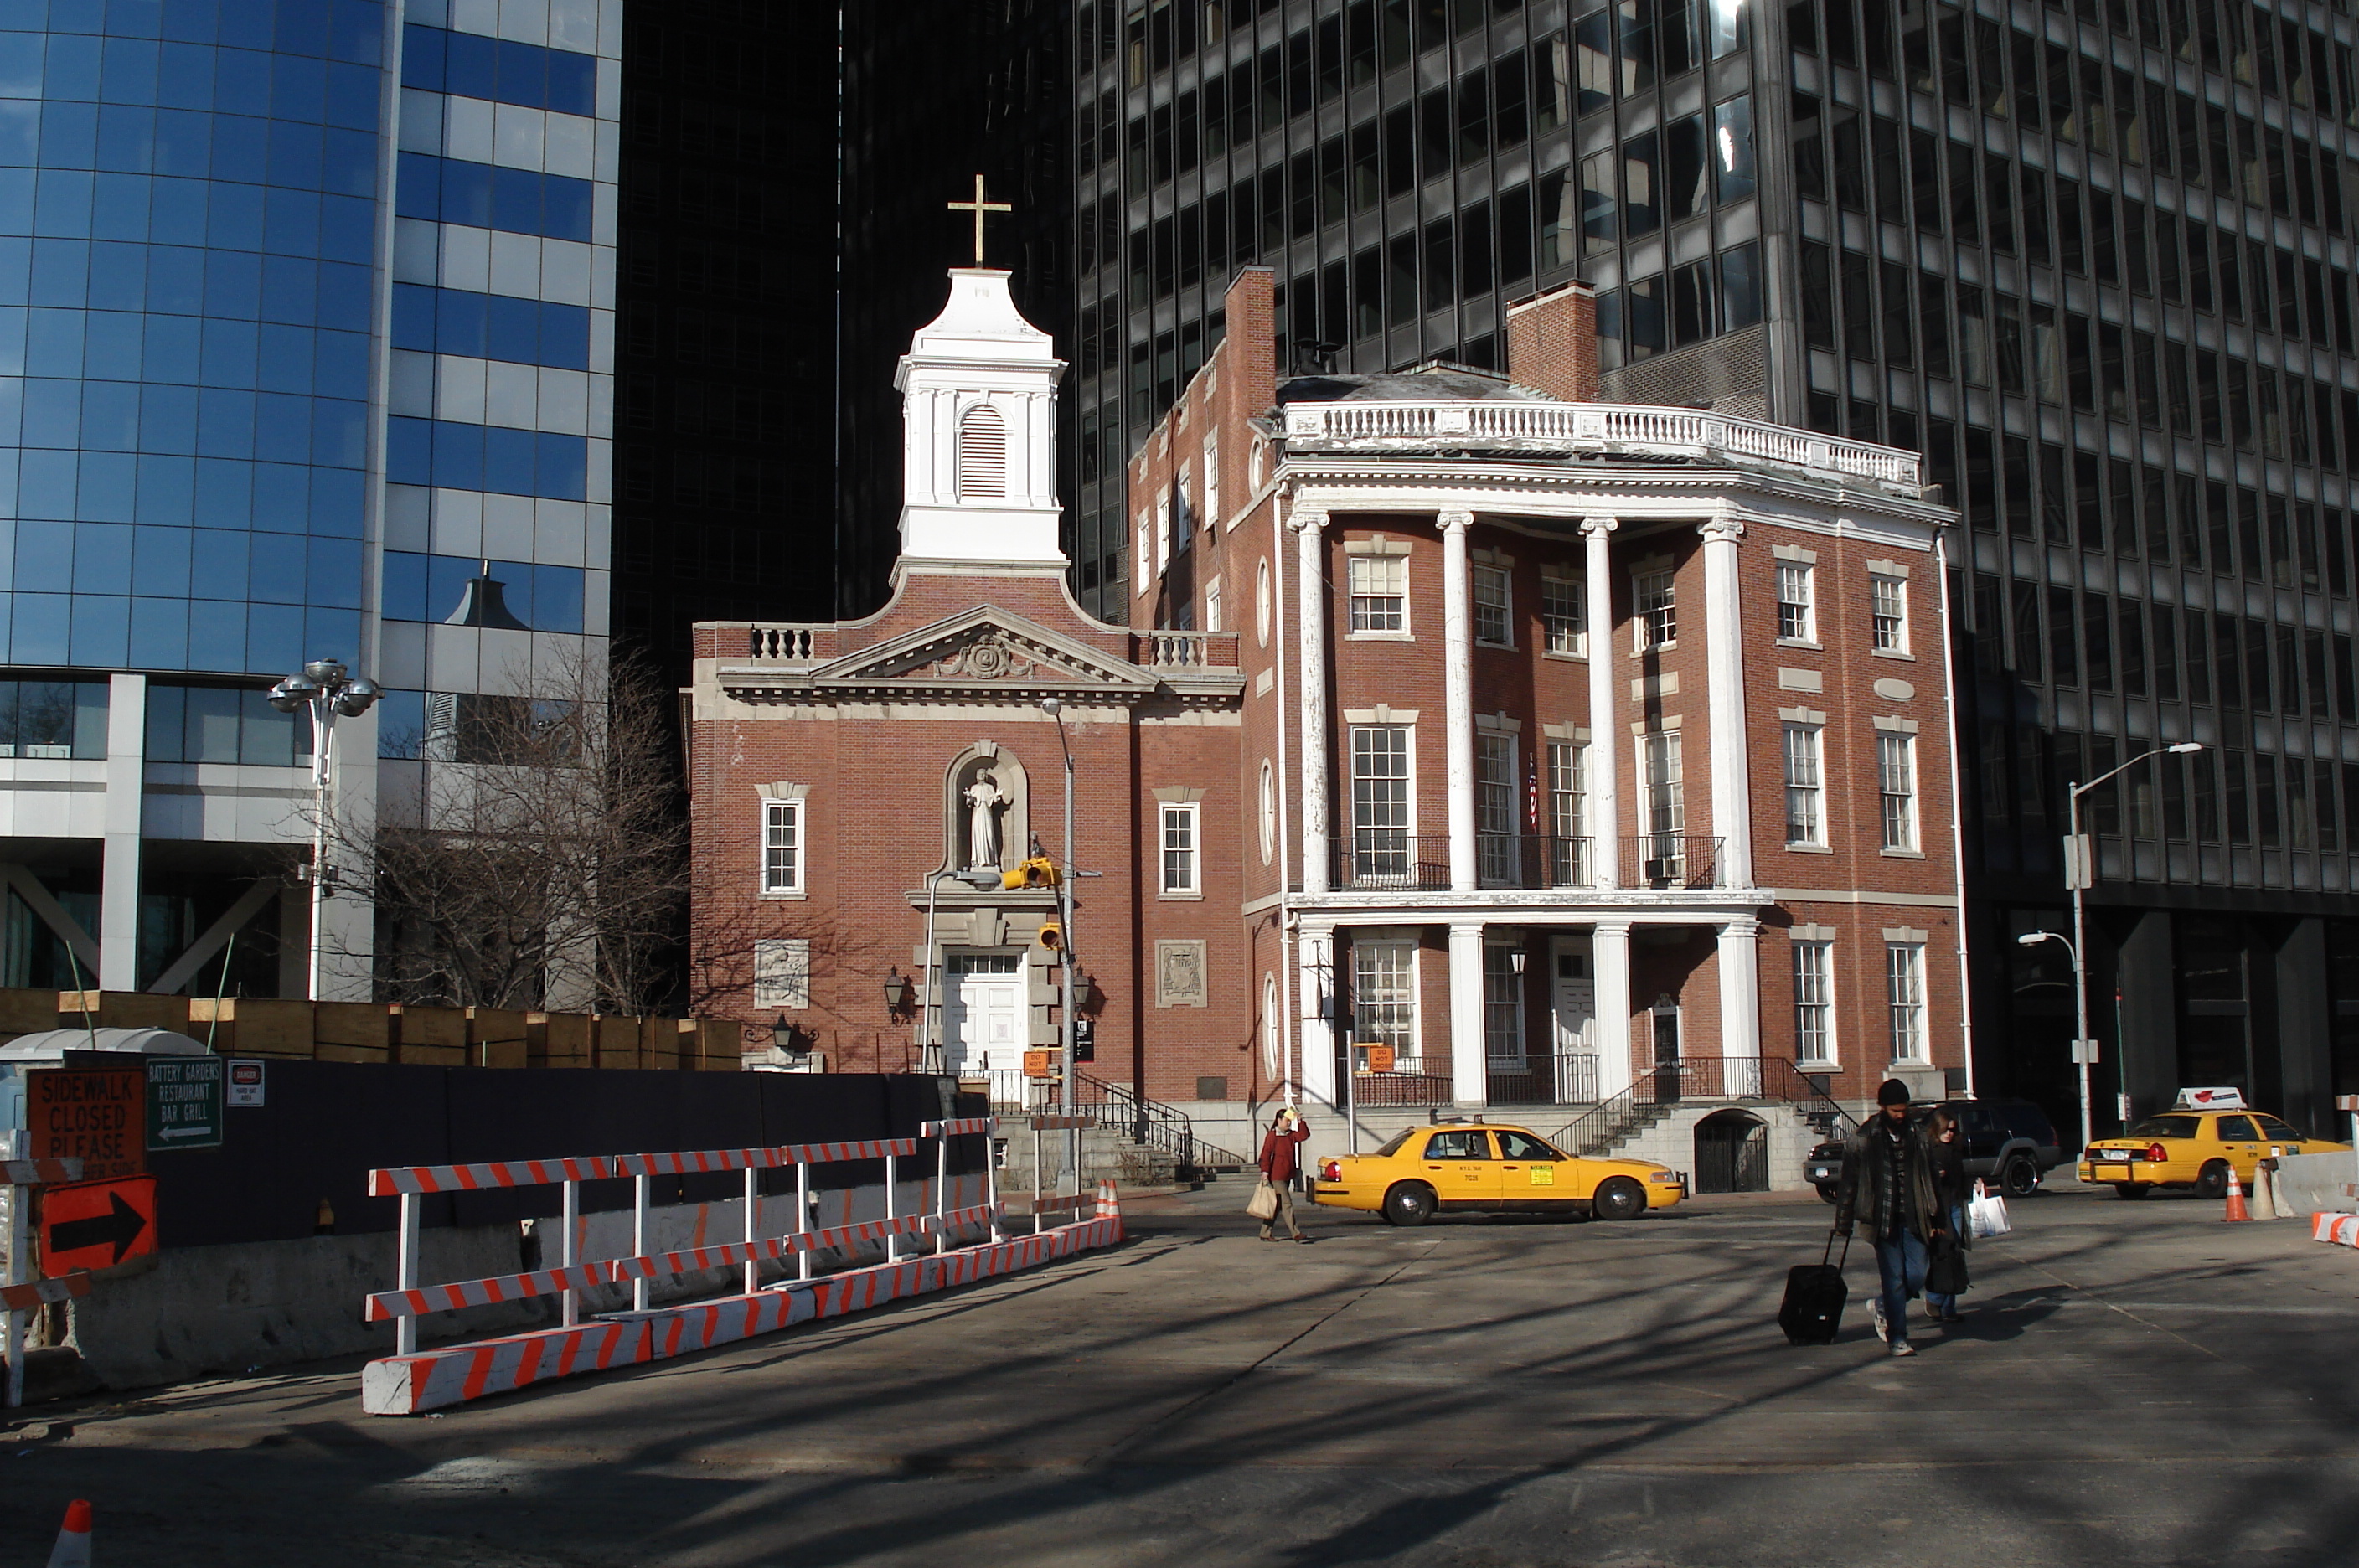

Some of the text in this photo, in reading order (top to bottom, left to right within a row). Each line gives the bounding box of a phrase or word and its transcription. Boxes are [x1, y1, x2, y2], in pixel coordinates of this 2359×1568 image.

[149, 1063, 219, 1083] BATTERY GARDENS
[237, 1070, 256, 1079] DANGER
[42, 1075, 132, 1103] SIDEWALK
[158, 1083, 209, 1102] RESTAURANT
[50, 1104, 126, 1132] CLOSED
[161, 1102, 208, 1122] BAR GRILL
[50, 1133, 124, 1160] PLEASE
